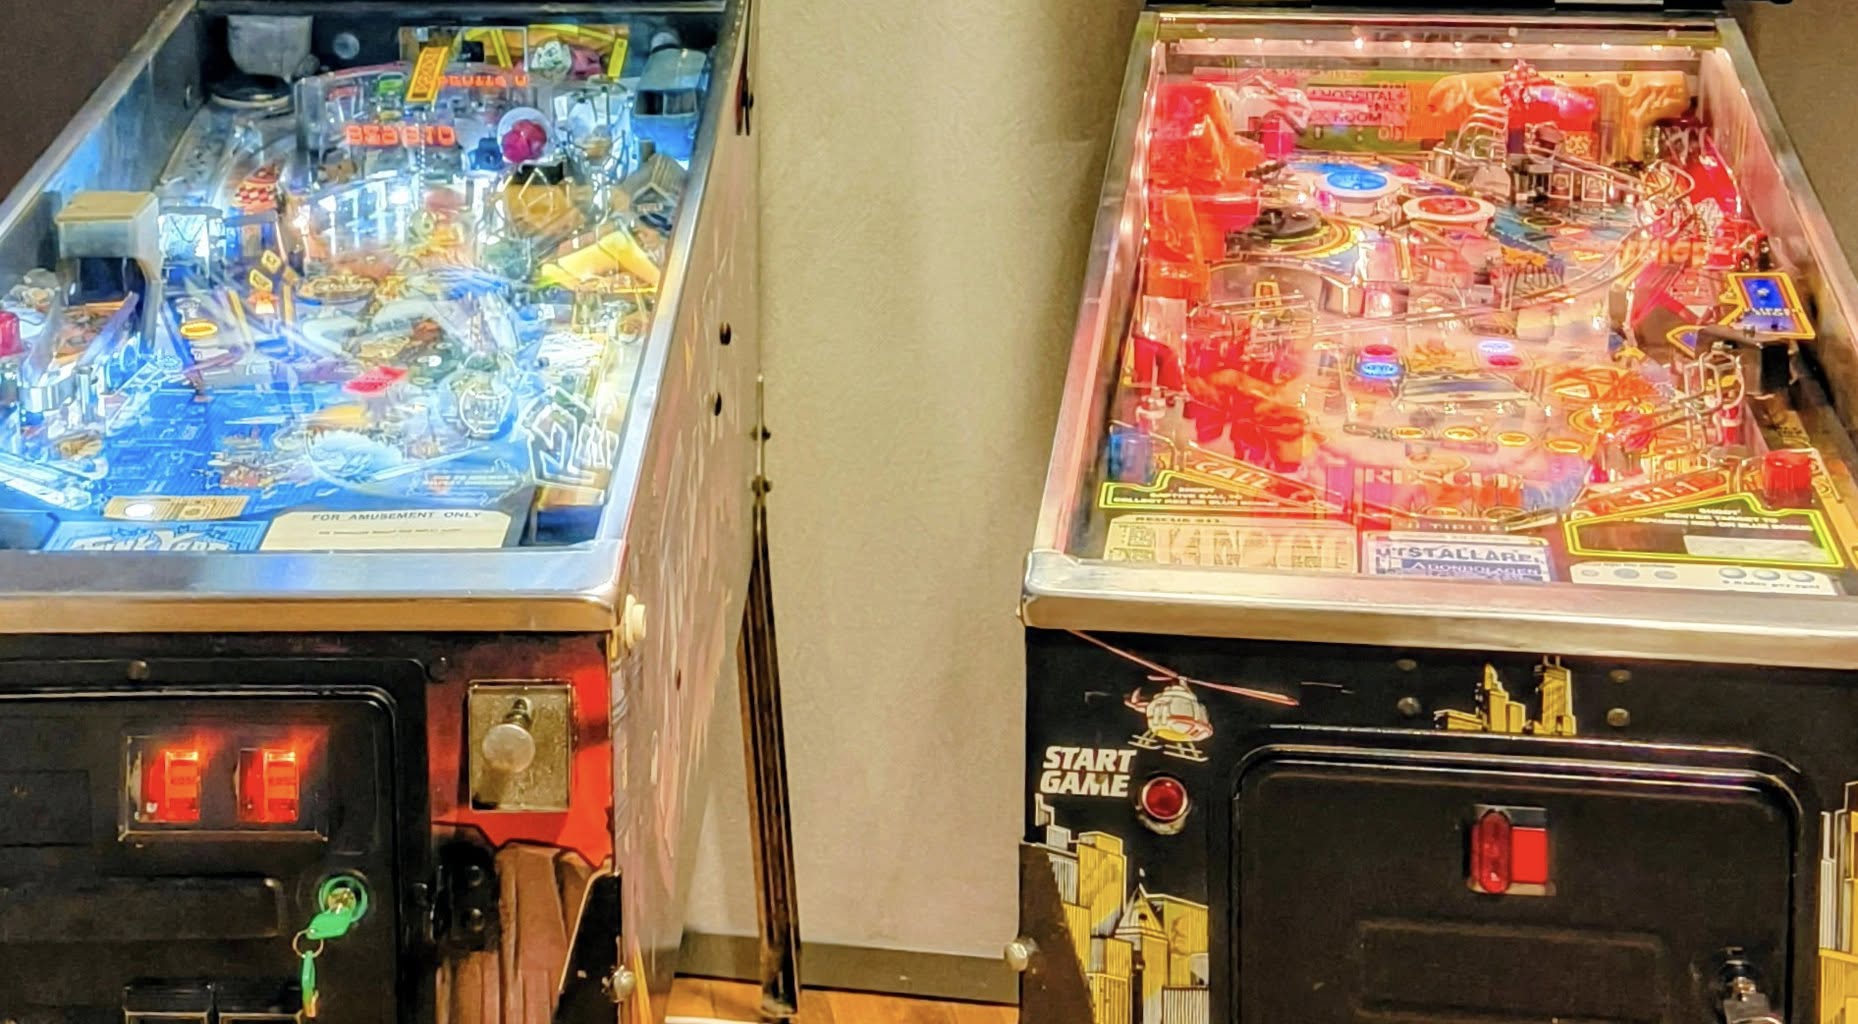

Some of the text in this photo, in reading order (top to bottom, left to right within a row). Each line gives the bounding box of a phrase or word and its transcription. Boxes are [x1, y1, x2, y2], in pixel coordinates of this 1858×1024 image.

[349, 512, 435, 521] AMUSEMENT
[443, 511, 482, 519] ONLY
[1043, 745, 1138, 773] START
[1040, 770, 1131, 797] GAME
